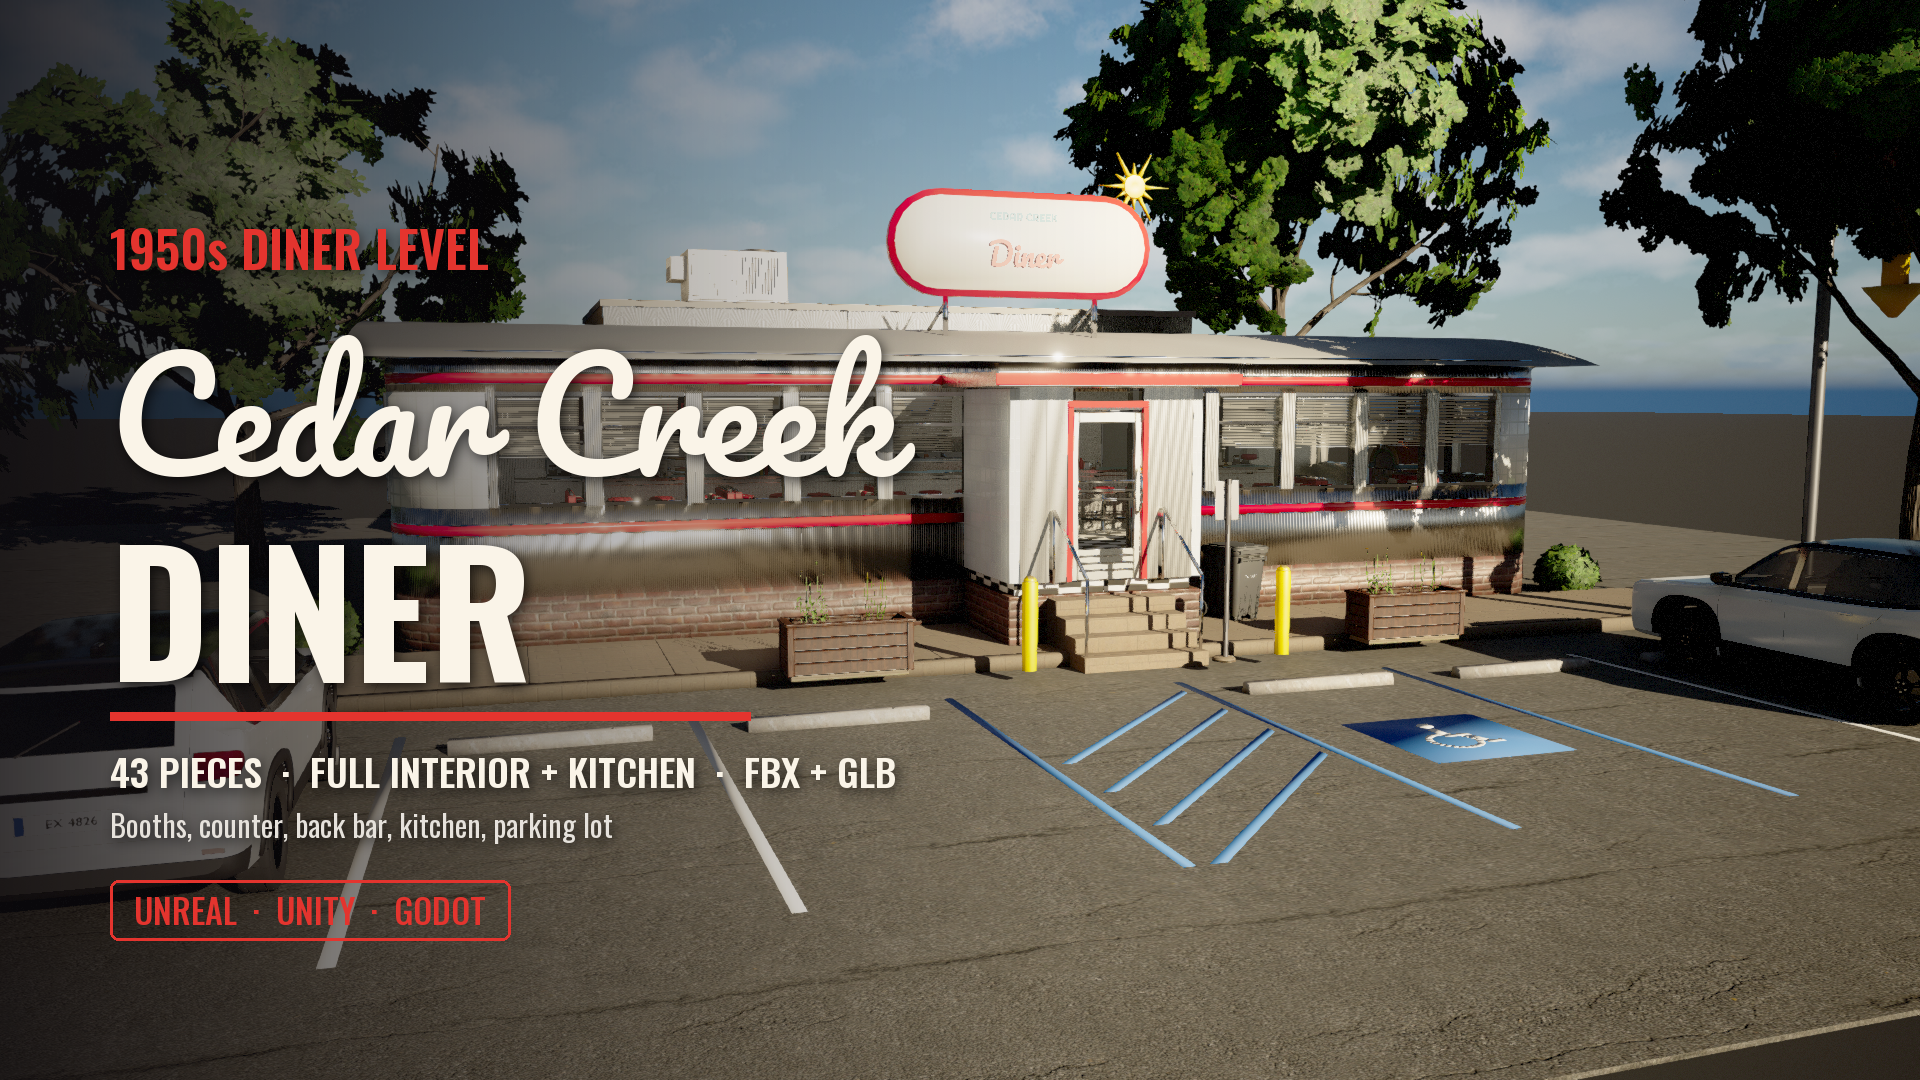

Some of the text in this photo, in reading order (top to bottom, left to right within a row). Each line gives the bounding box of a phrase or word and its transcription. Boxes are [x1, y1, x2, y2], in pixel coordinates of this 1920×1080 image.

[990, 212, 1057, 222] CEDAR CREEK
[989, 239, 1064, 269] Diner
[45, 816, 98, 829] EX 4826
